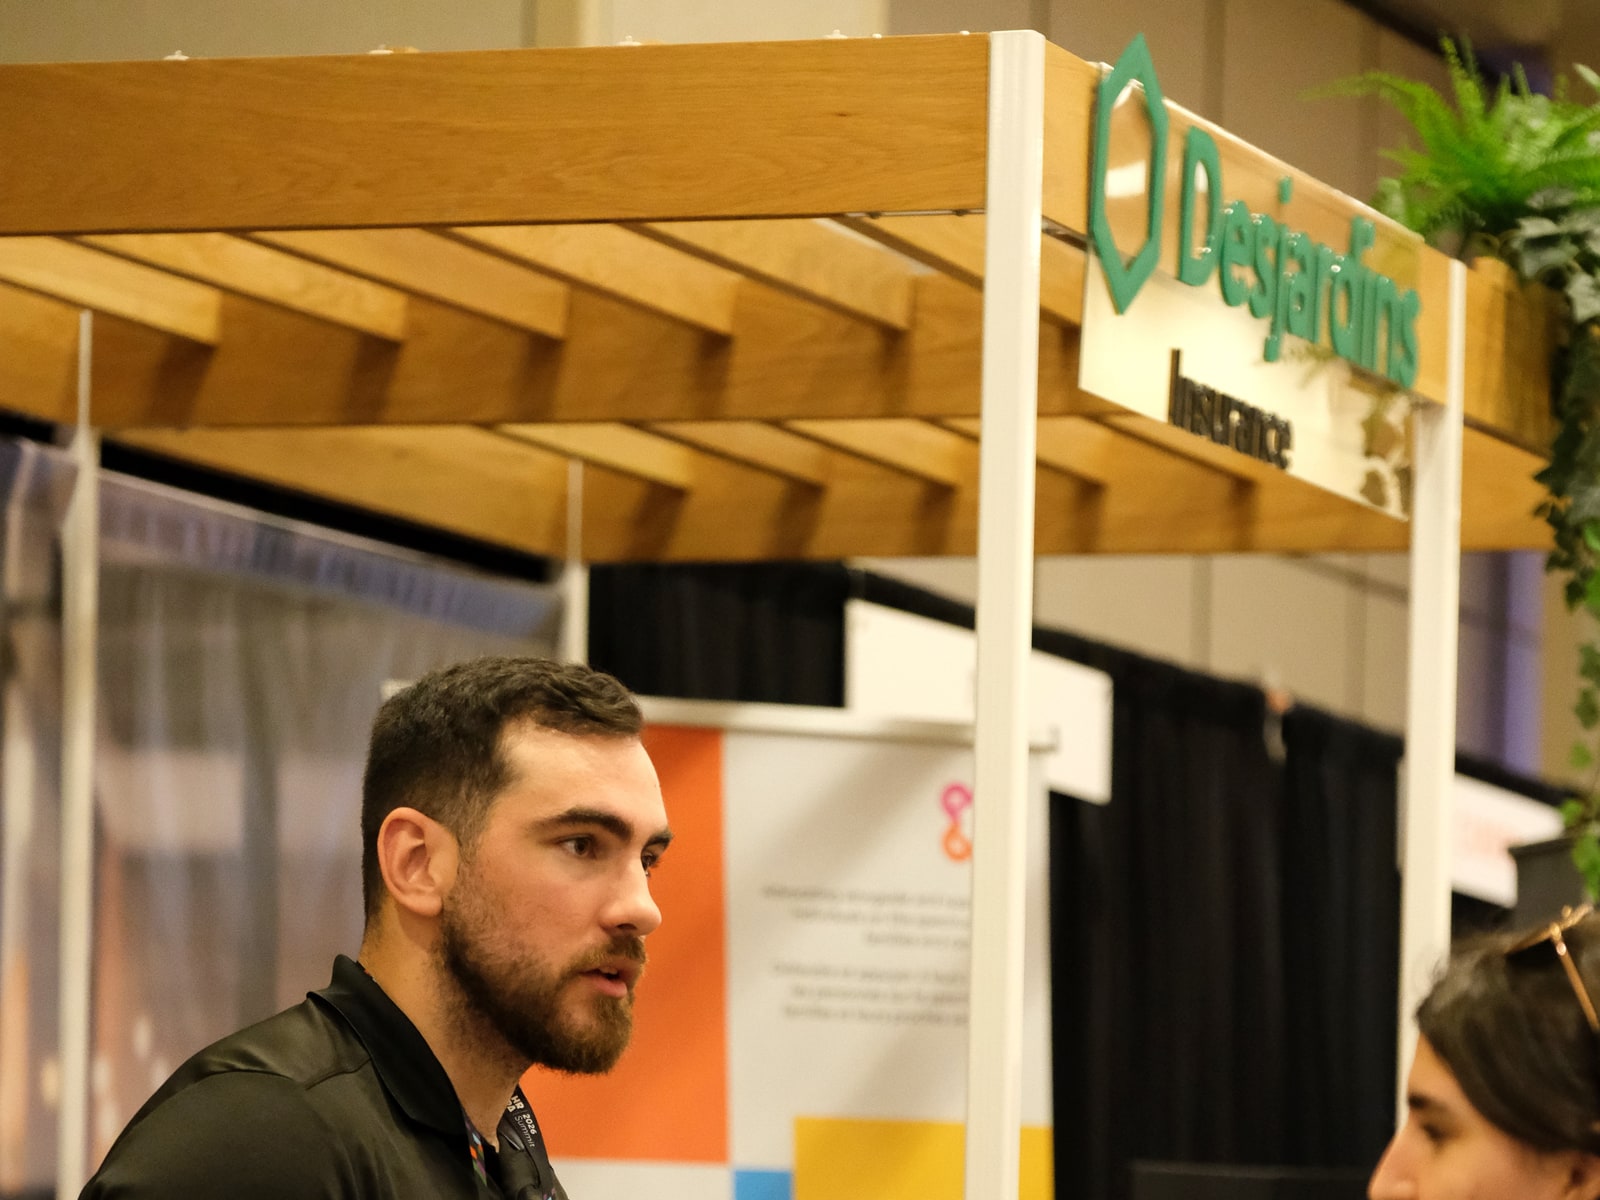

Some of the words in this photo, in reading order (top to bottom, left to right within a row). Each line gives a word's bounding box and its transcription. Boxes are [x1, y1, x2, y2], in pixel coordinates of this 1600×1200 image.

[1179, 125, 1421, 389] Desjardins
[1168, 348, 1292, 470] Insurance
[511, 1095, 525, 1109] HR
[514, 1115, 536, 1147] Summit
[523, 1113, 538, 1135] 2026
